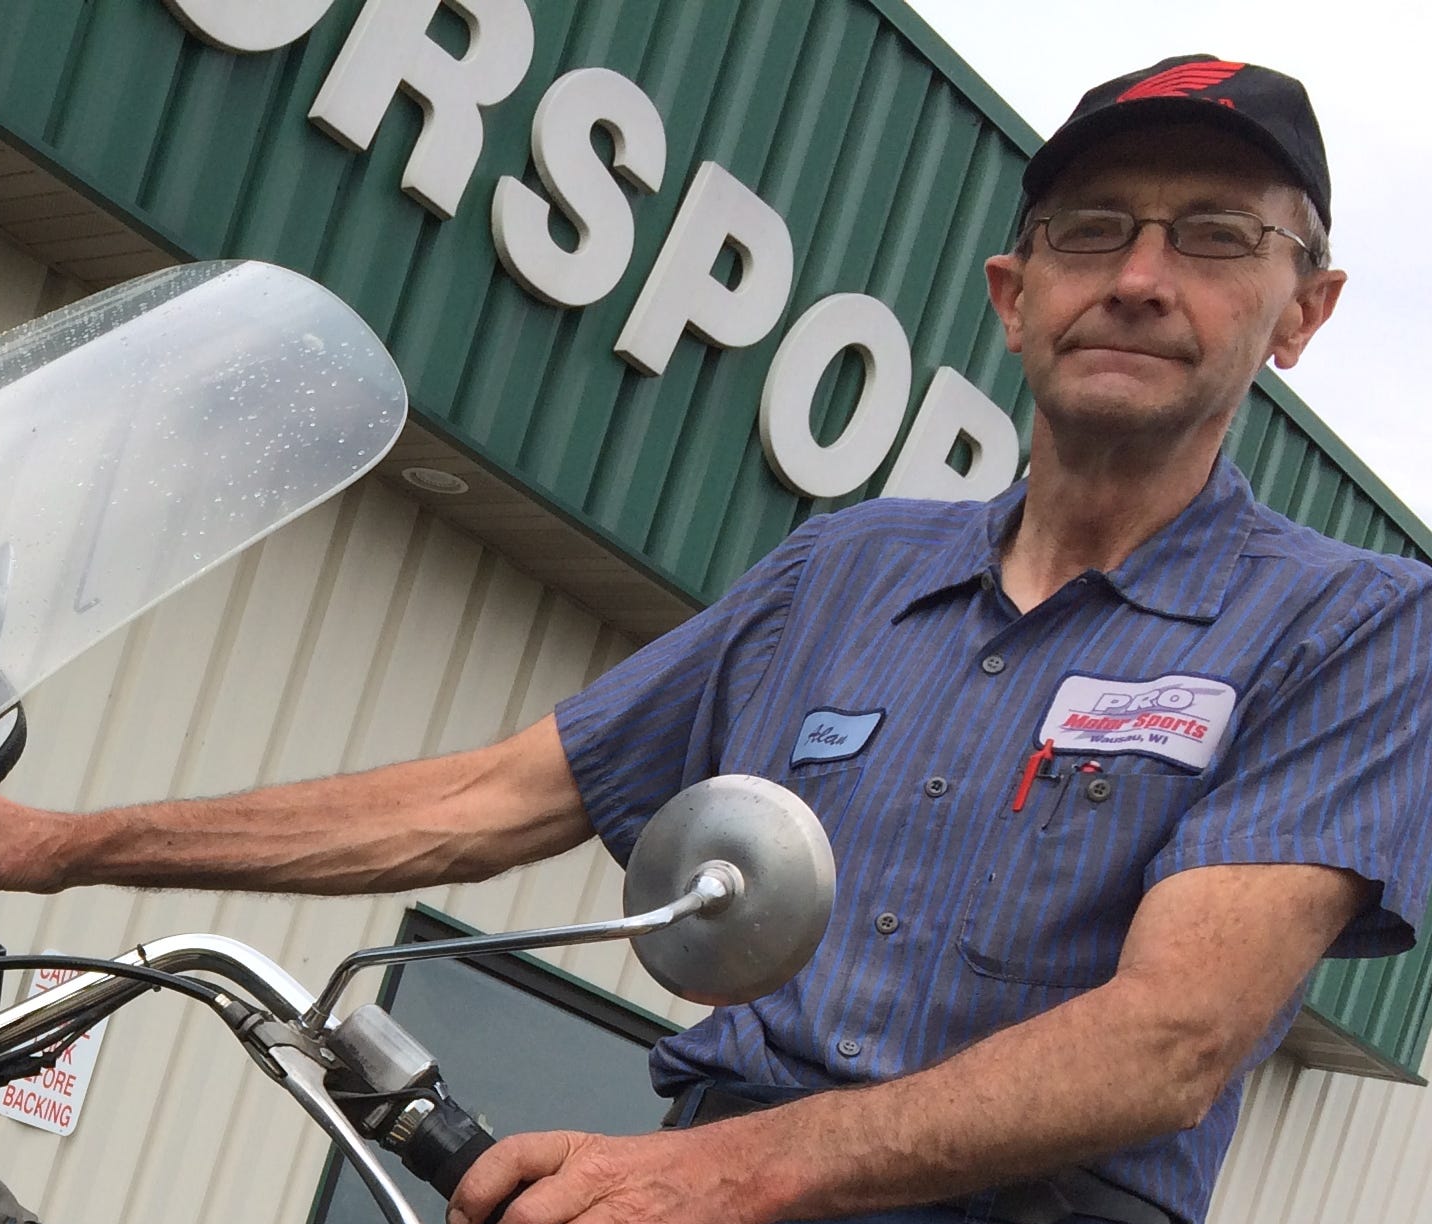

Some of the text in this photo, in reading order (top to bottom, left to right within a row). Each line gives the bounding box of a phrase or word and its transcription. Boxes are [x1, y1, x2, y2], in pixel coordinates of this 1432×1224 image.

[1092, 688, 1195, 714] PRO
[804, 724, 848, 746] Alan
[1063, 713, 1208, 739] Motor Sports
[1090, 733, 1168, 745] Wausau, WI
[2, 1084, 73, 1128] BACKING
